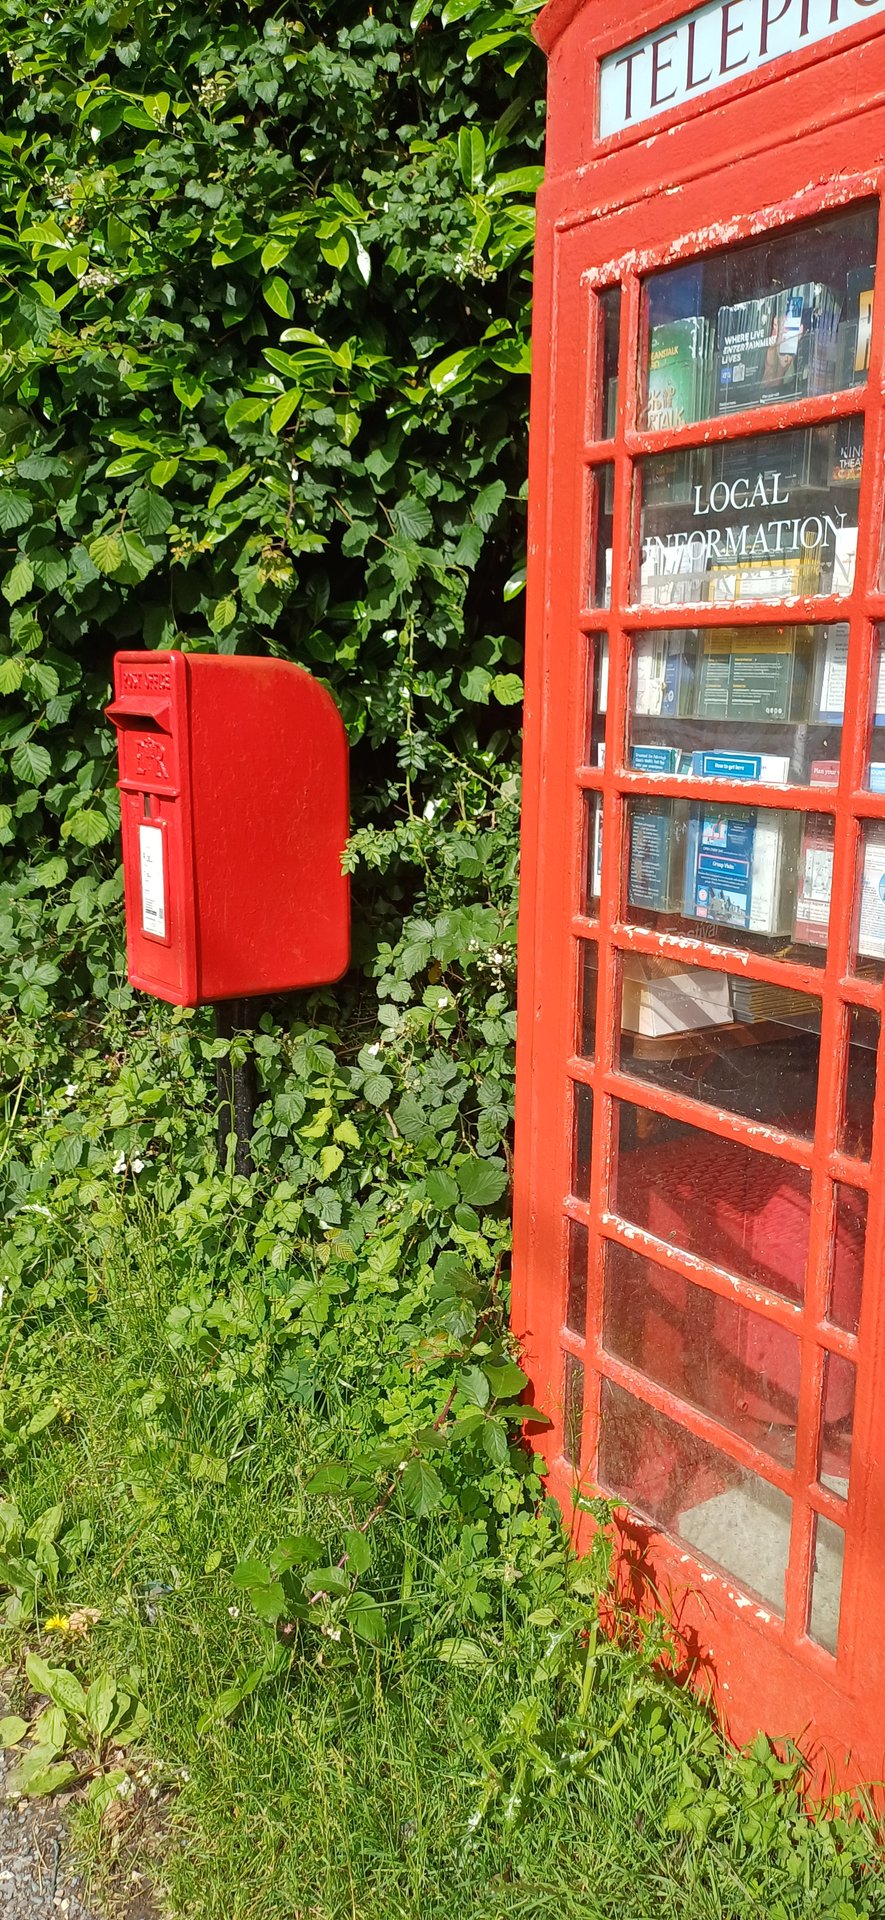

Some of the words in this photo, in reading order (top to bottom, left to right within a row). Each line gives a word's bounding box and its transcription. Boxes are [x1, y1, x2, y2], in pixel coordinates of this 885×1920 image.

[615, 0, 879, 120] TELEP
[722, 336, 777, 355] ENTERTAINMENT
[724, 332, 749, 345] WHERE
[751, 328, 765, 338] LIVE
[721, 353, 741, 365] LIVES
[841, 445, 863, 458] KIN
[693, 472, 789, 515] LOCAL
[645, 504, 847, 562] INFORMATION
[123, 671, 142, 690] POST
